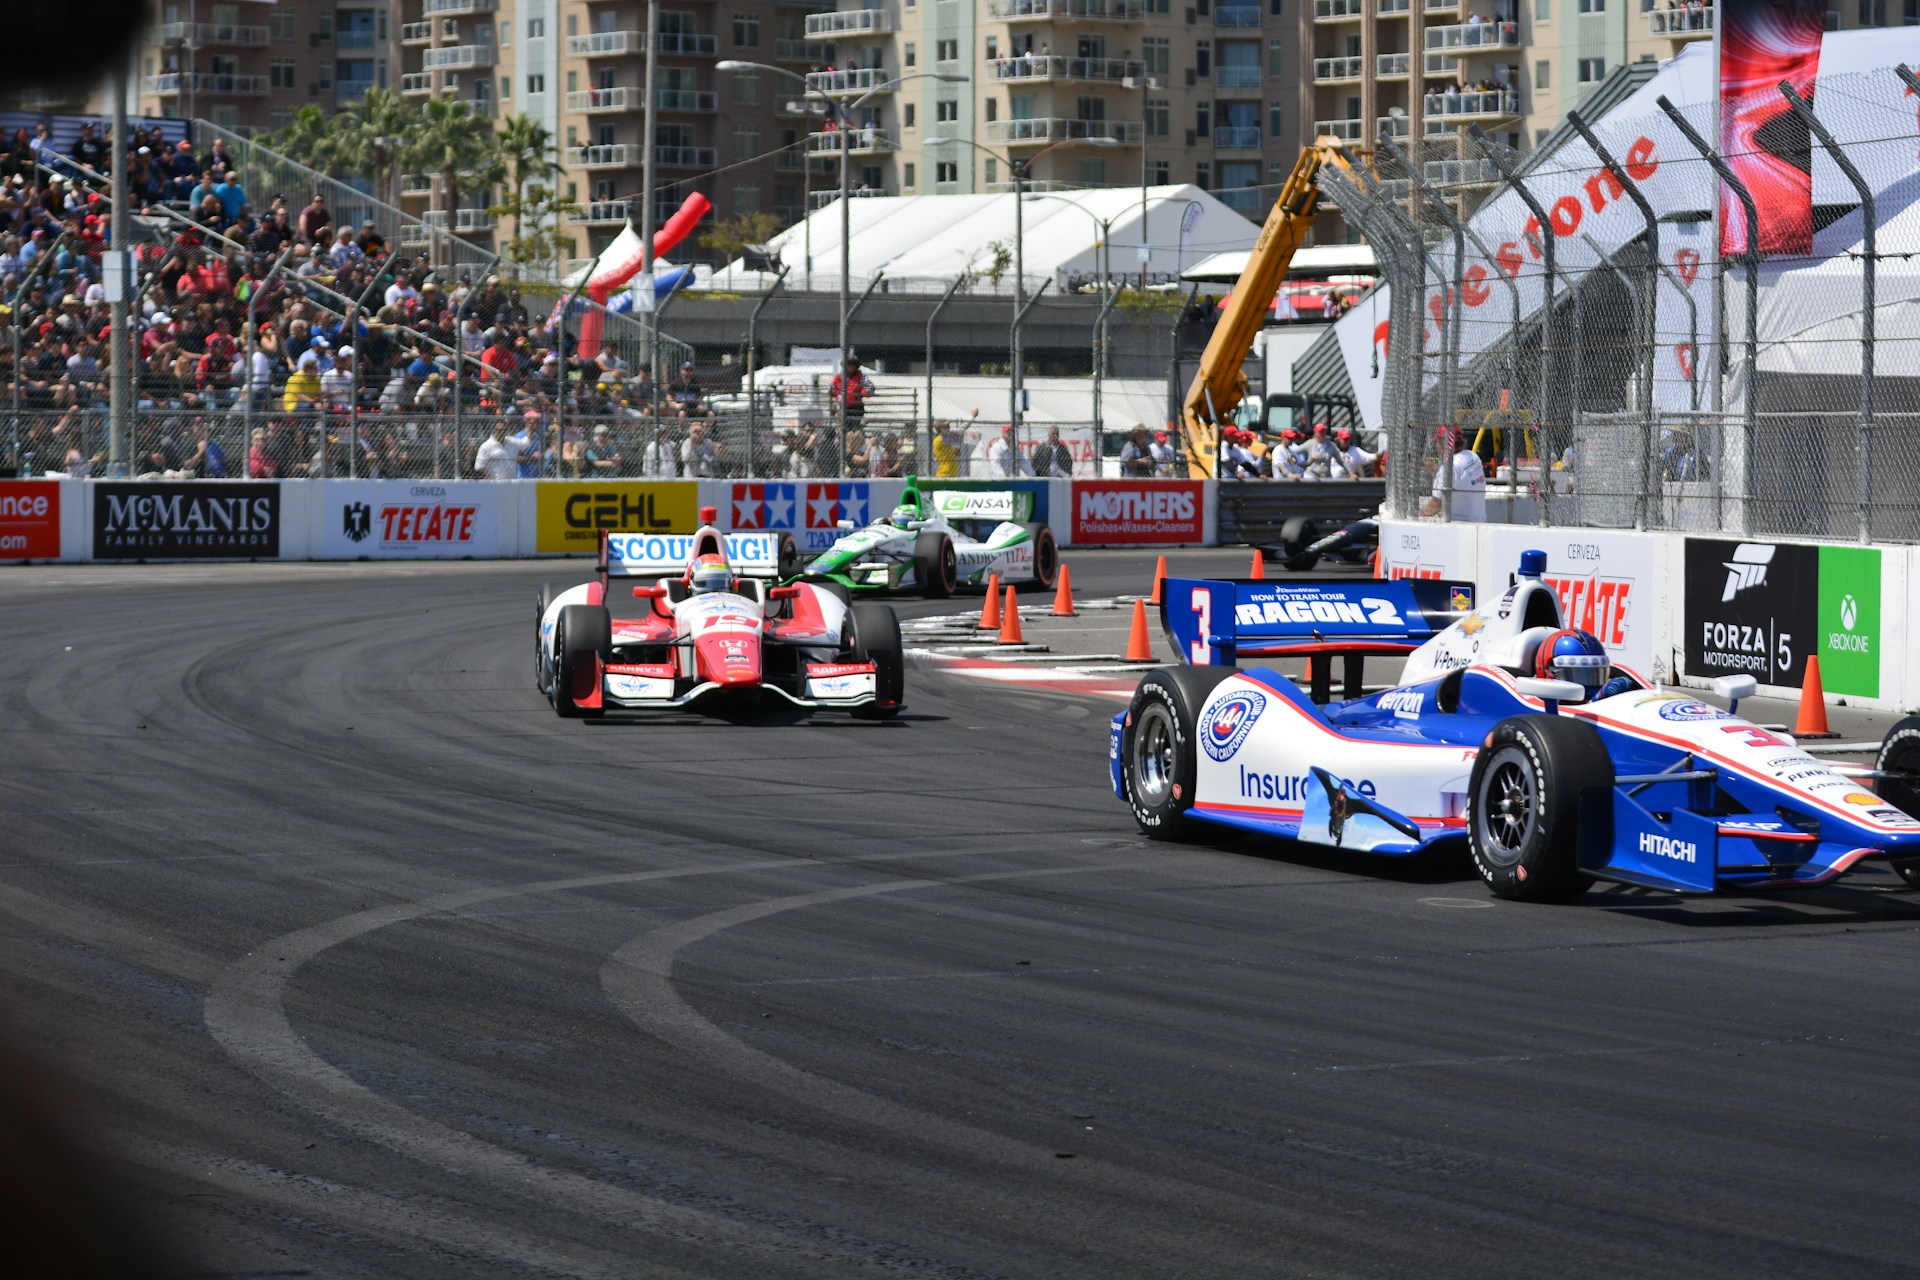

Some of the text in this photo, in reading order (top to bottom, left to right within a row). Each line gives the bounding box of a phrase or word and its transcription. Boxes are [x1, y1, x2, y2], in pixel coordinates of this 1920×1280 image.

[410, 487, 446, 496] CERVEZA
[0, 496, 48, 516] nce
[104, 495, 270, 532] McMANIS
[565, 493, 671, 528] GEHL
[1080, 491, 1195, 520] MOTHERS
[379, 504, 477, 541] TECATE
[0, 535, 27, 548] om
[105, 534, 268, 545] FAMILY VINEYARDS
[608, 537, 770, 561] SCOUNG!
[806, 530, 842, 548] TAM
[1401, 534, 1421, 550] CERVEZA
[1567, 543, 1601, 561] CERVEZA
[1289, 593, 1320, 601] TRAIN
[703, 614, 759, 629] 19
[1235, 597, 1405, 626] RAGON 2
[1191, 586, 1211, 666] 3
[1703, 621, 1766, 653] FORZA
[1778, 633, 1791, 671] 5
[1828, 633, 1869, 652] XBOX ONE
[1376, 687, 1424, 720] verizon
[1214, 707, 1244, 728] AAA
[1720, 726, 1791, 747] 3
[1240, 764, 1376, 801] Insure
[1639, 832, 1697, 863] HITACHI
